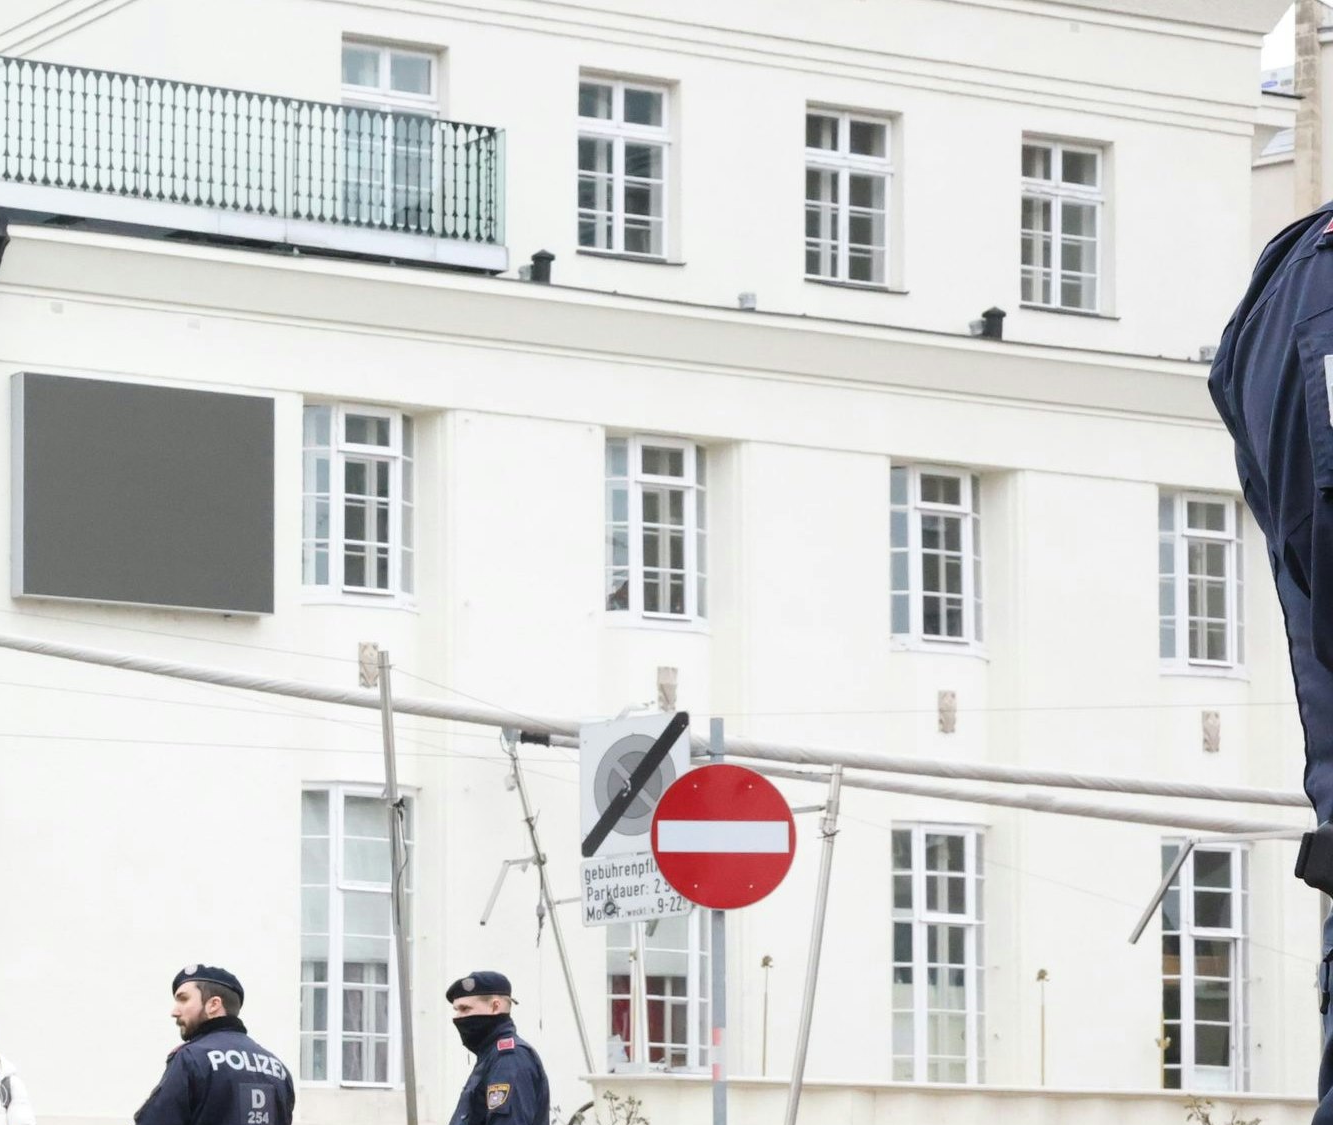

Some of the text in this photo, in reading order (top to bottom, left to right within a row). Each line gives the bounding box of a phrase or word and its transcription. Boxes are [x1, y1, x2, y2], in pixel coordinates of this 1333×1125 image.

[587, 884, 649, 902] Parkdauer:
[252, 1088, 266, 1109] D
[247, 1111, 269, 1125] 254
